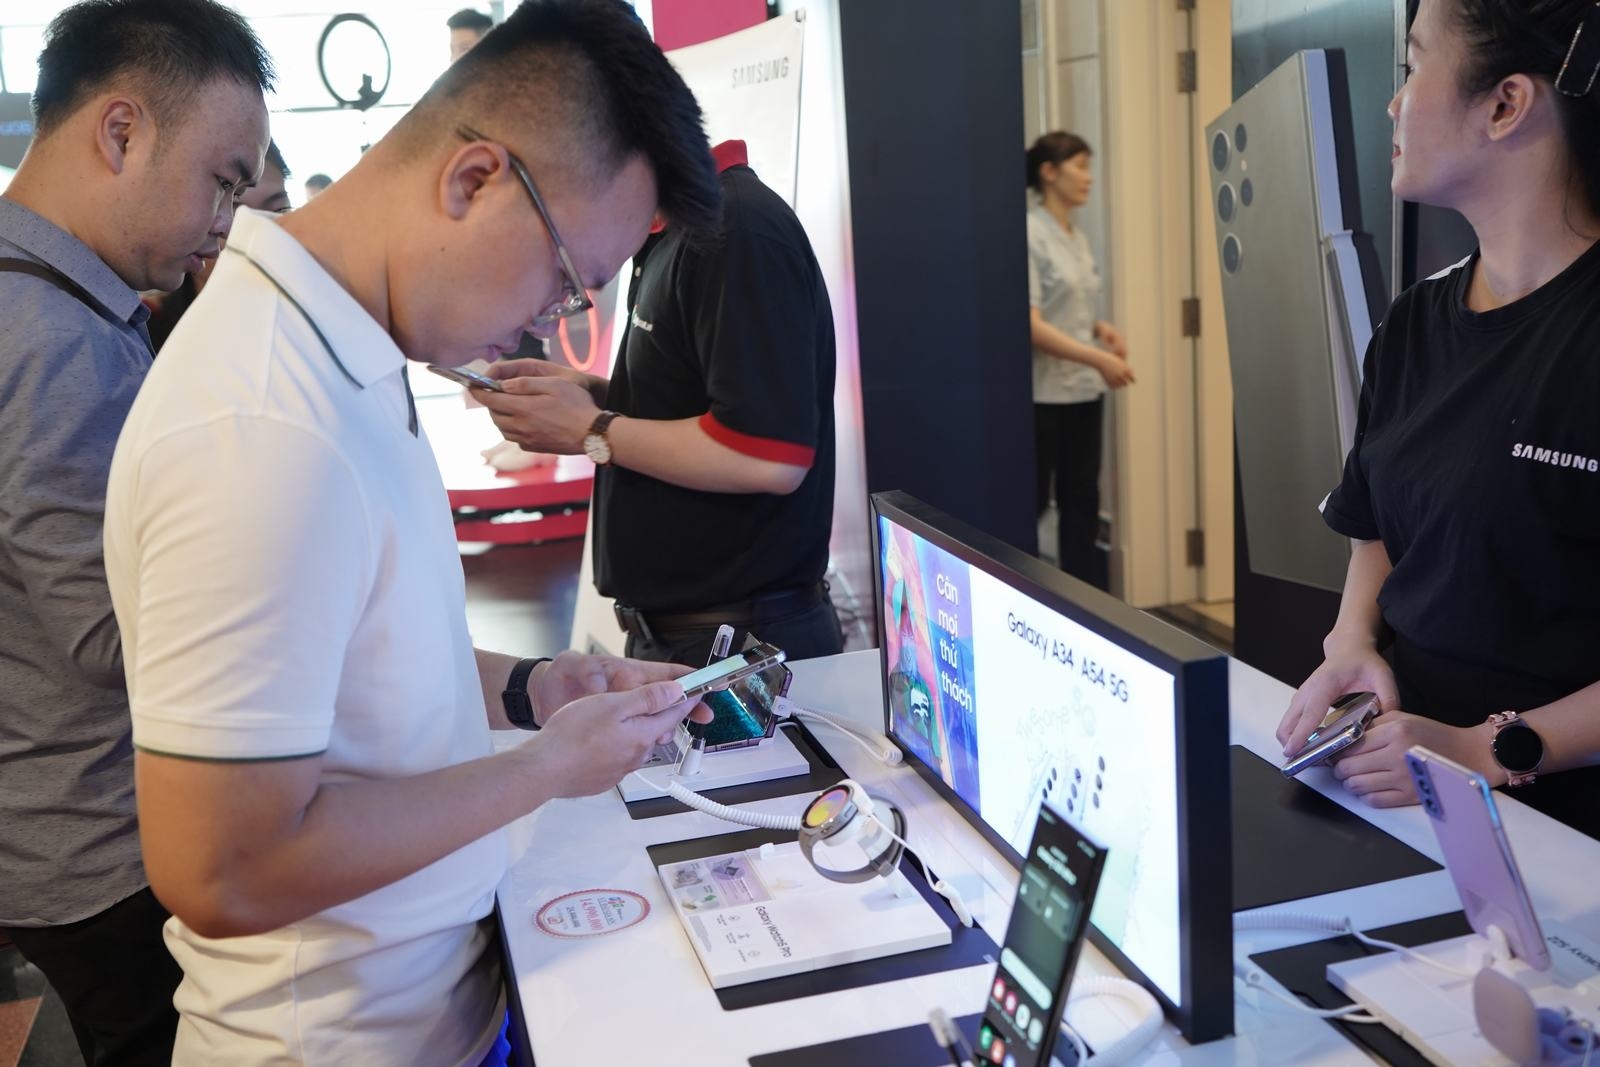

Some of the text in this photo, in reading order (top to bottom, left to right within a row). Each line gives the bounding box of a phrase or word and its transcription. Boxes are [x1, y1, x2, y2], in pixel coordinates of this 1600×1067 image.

[731, 57, 789, 88] SAMSUNG
[1511, 443, 1598, 472] SAMSUNG
[940, 637, 958, 669] thử
[1008, 612, 1128, 702] Galaxy A34 A54 5G
[942, 670, 973, 713] thách
[755, 906, 773, 926] Galaxy
[780, 946, 792, 958] Pro
